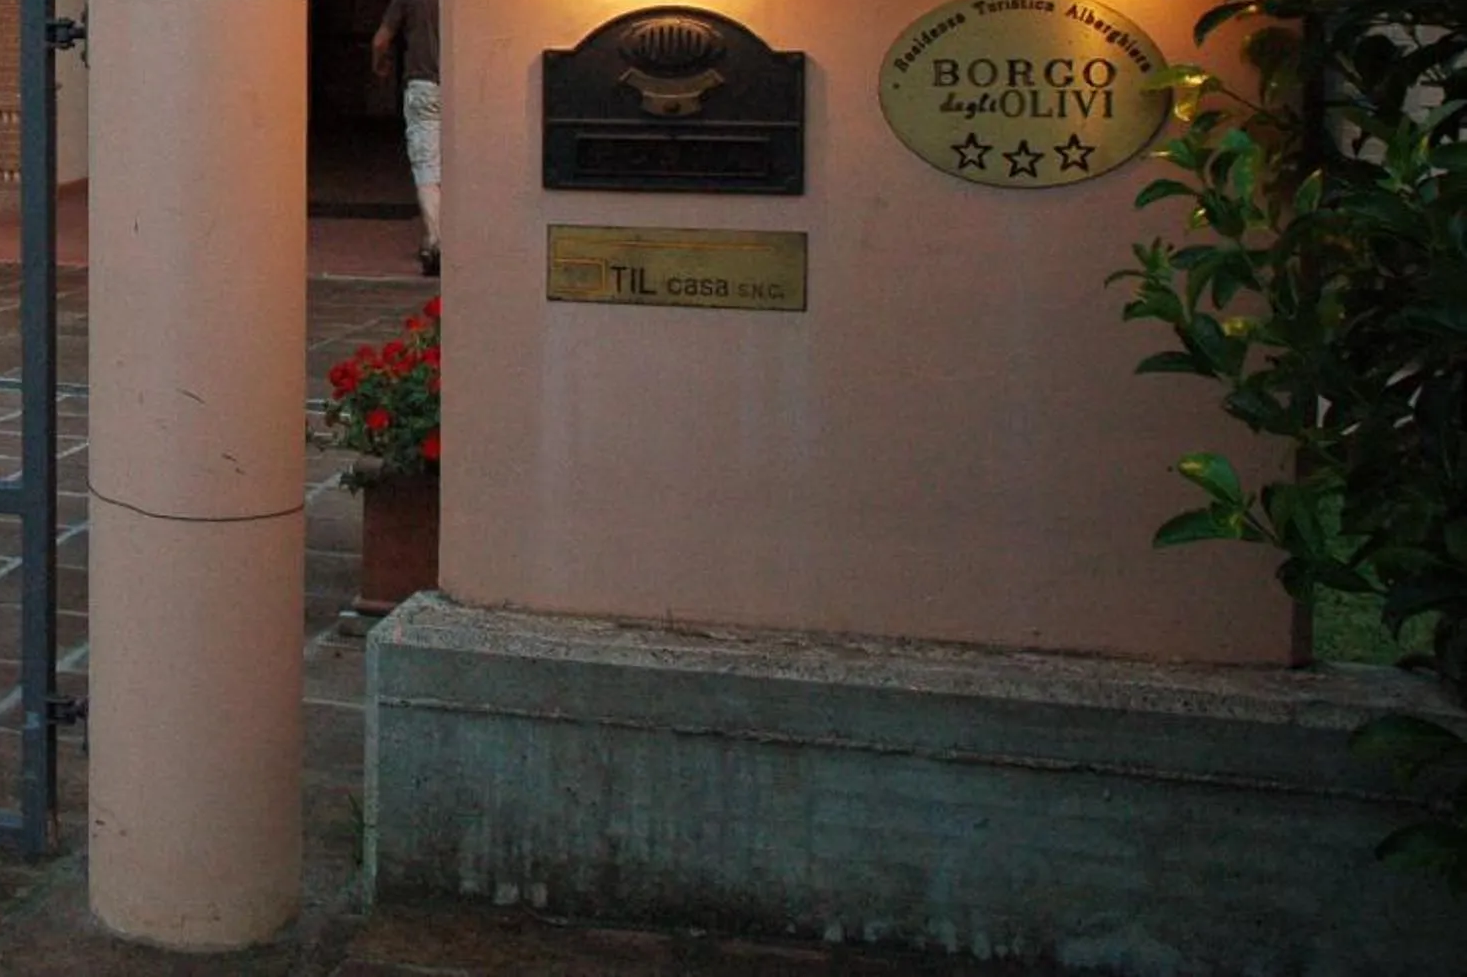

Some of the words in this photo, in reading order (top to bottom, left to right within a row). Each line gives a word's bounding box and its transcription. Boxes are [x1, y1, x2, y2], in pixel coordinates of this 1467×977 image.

[932, 57, 1117, 89] BORGO
[939, 91, 997, 120] degli
[999, 89, 1113, 119] OLIVI
[609, 265, 658, 295] TIL
[666, 276, 729, 297] casa
